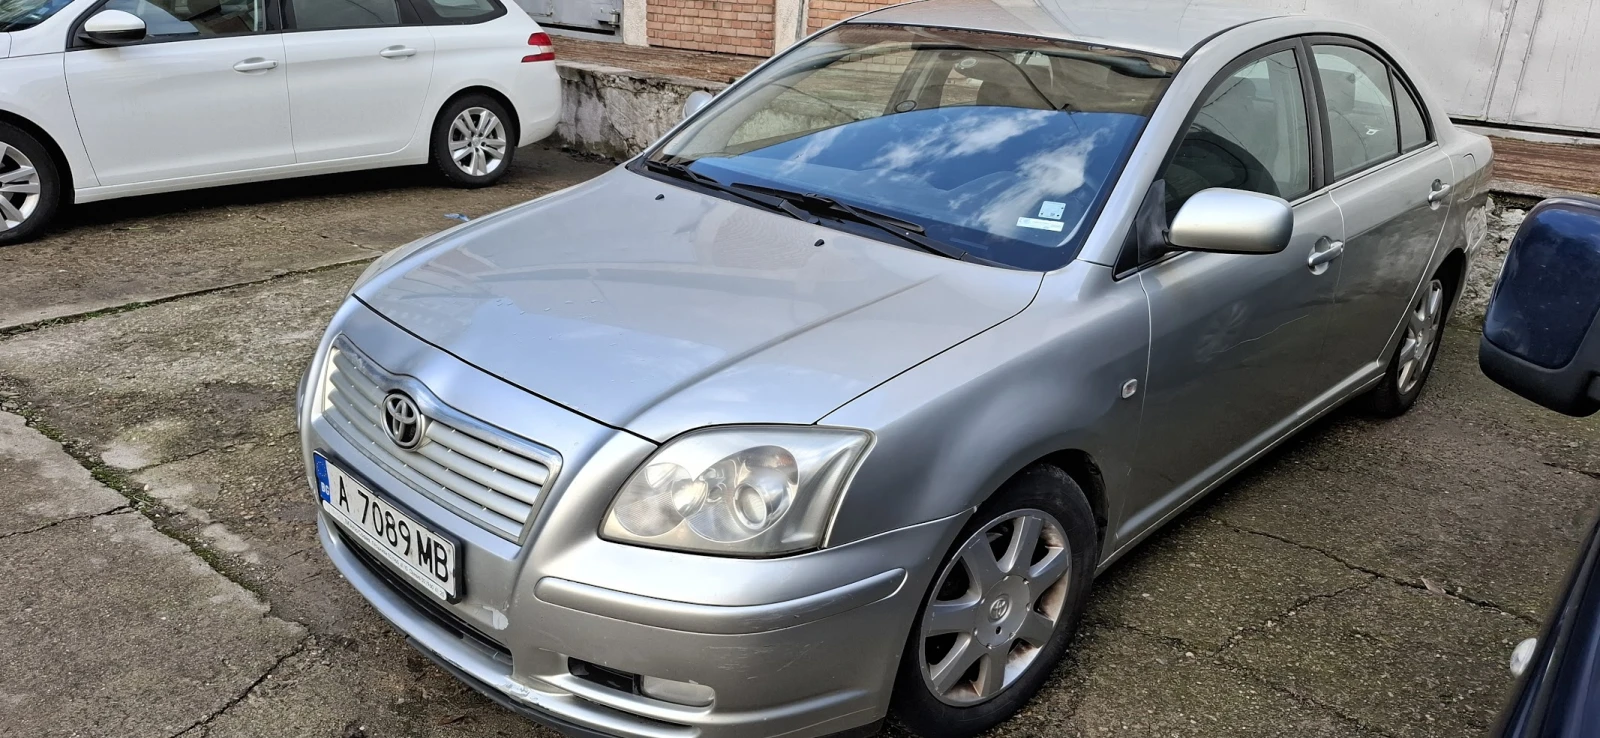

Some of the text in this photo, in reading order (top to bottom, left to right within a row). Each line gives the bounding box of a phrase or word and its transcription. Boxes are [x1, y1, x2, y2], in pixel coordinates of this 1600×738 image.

[320, 481, 330, 496] BG
[339, 475, 350, 513] A
[357, 489, 412, 556] 7089
[416, 529, 449, 583] MB
